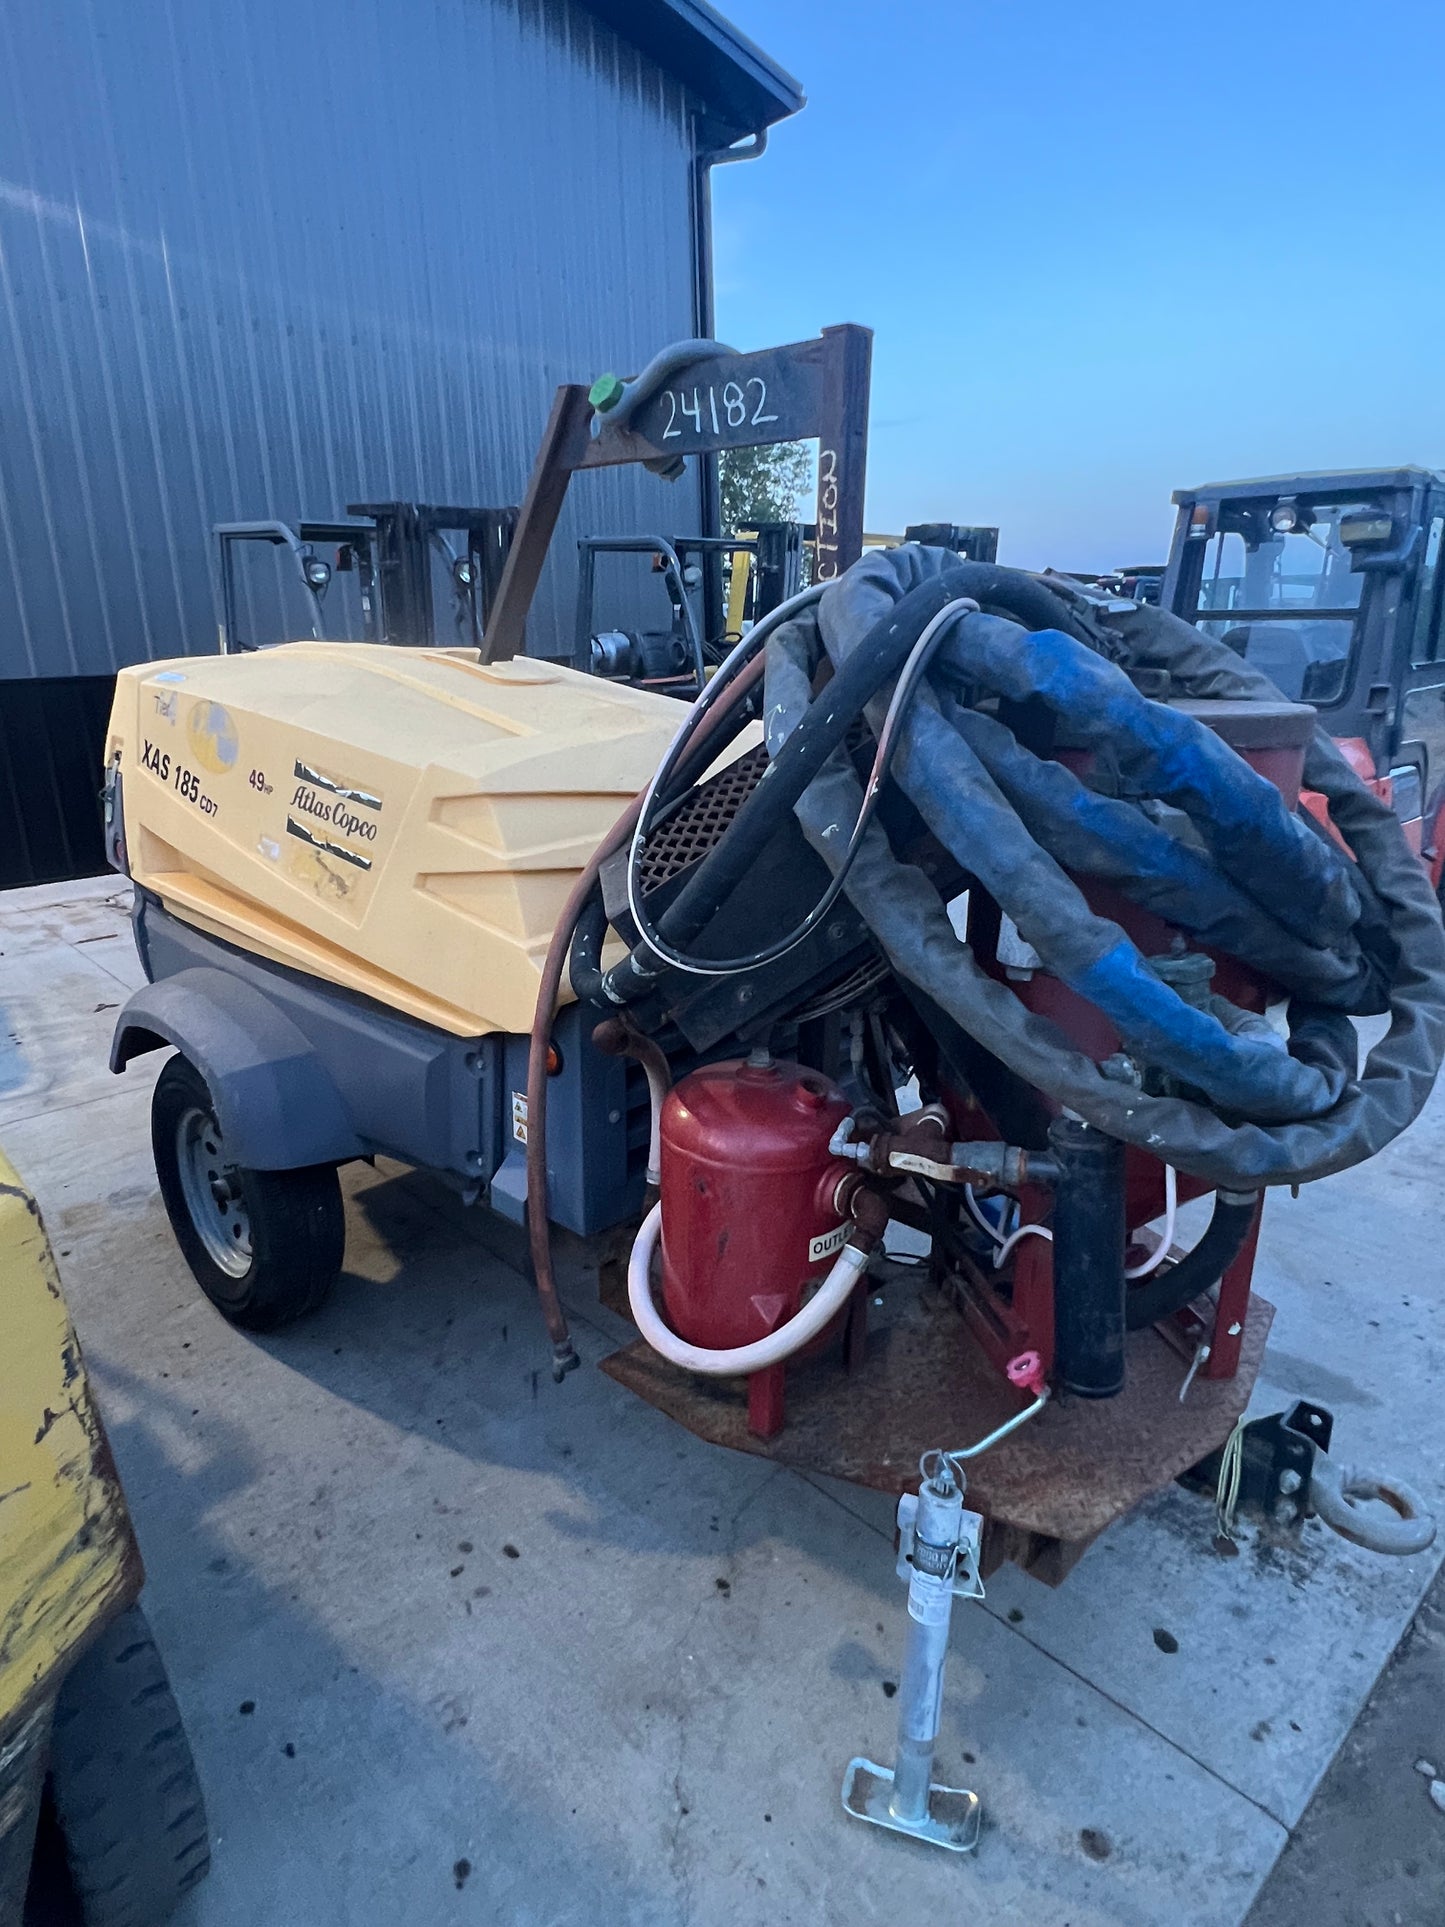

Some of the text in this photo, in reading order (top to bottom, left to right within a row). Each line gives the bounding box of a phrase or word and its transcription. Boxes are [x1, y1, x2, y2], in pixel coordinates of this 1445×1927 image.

[659, 377, 779, 440] 24182
[142, 739, 218, 818] XAS 185 CD7
[813, 1226, 851, 1254] OUTLE
